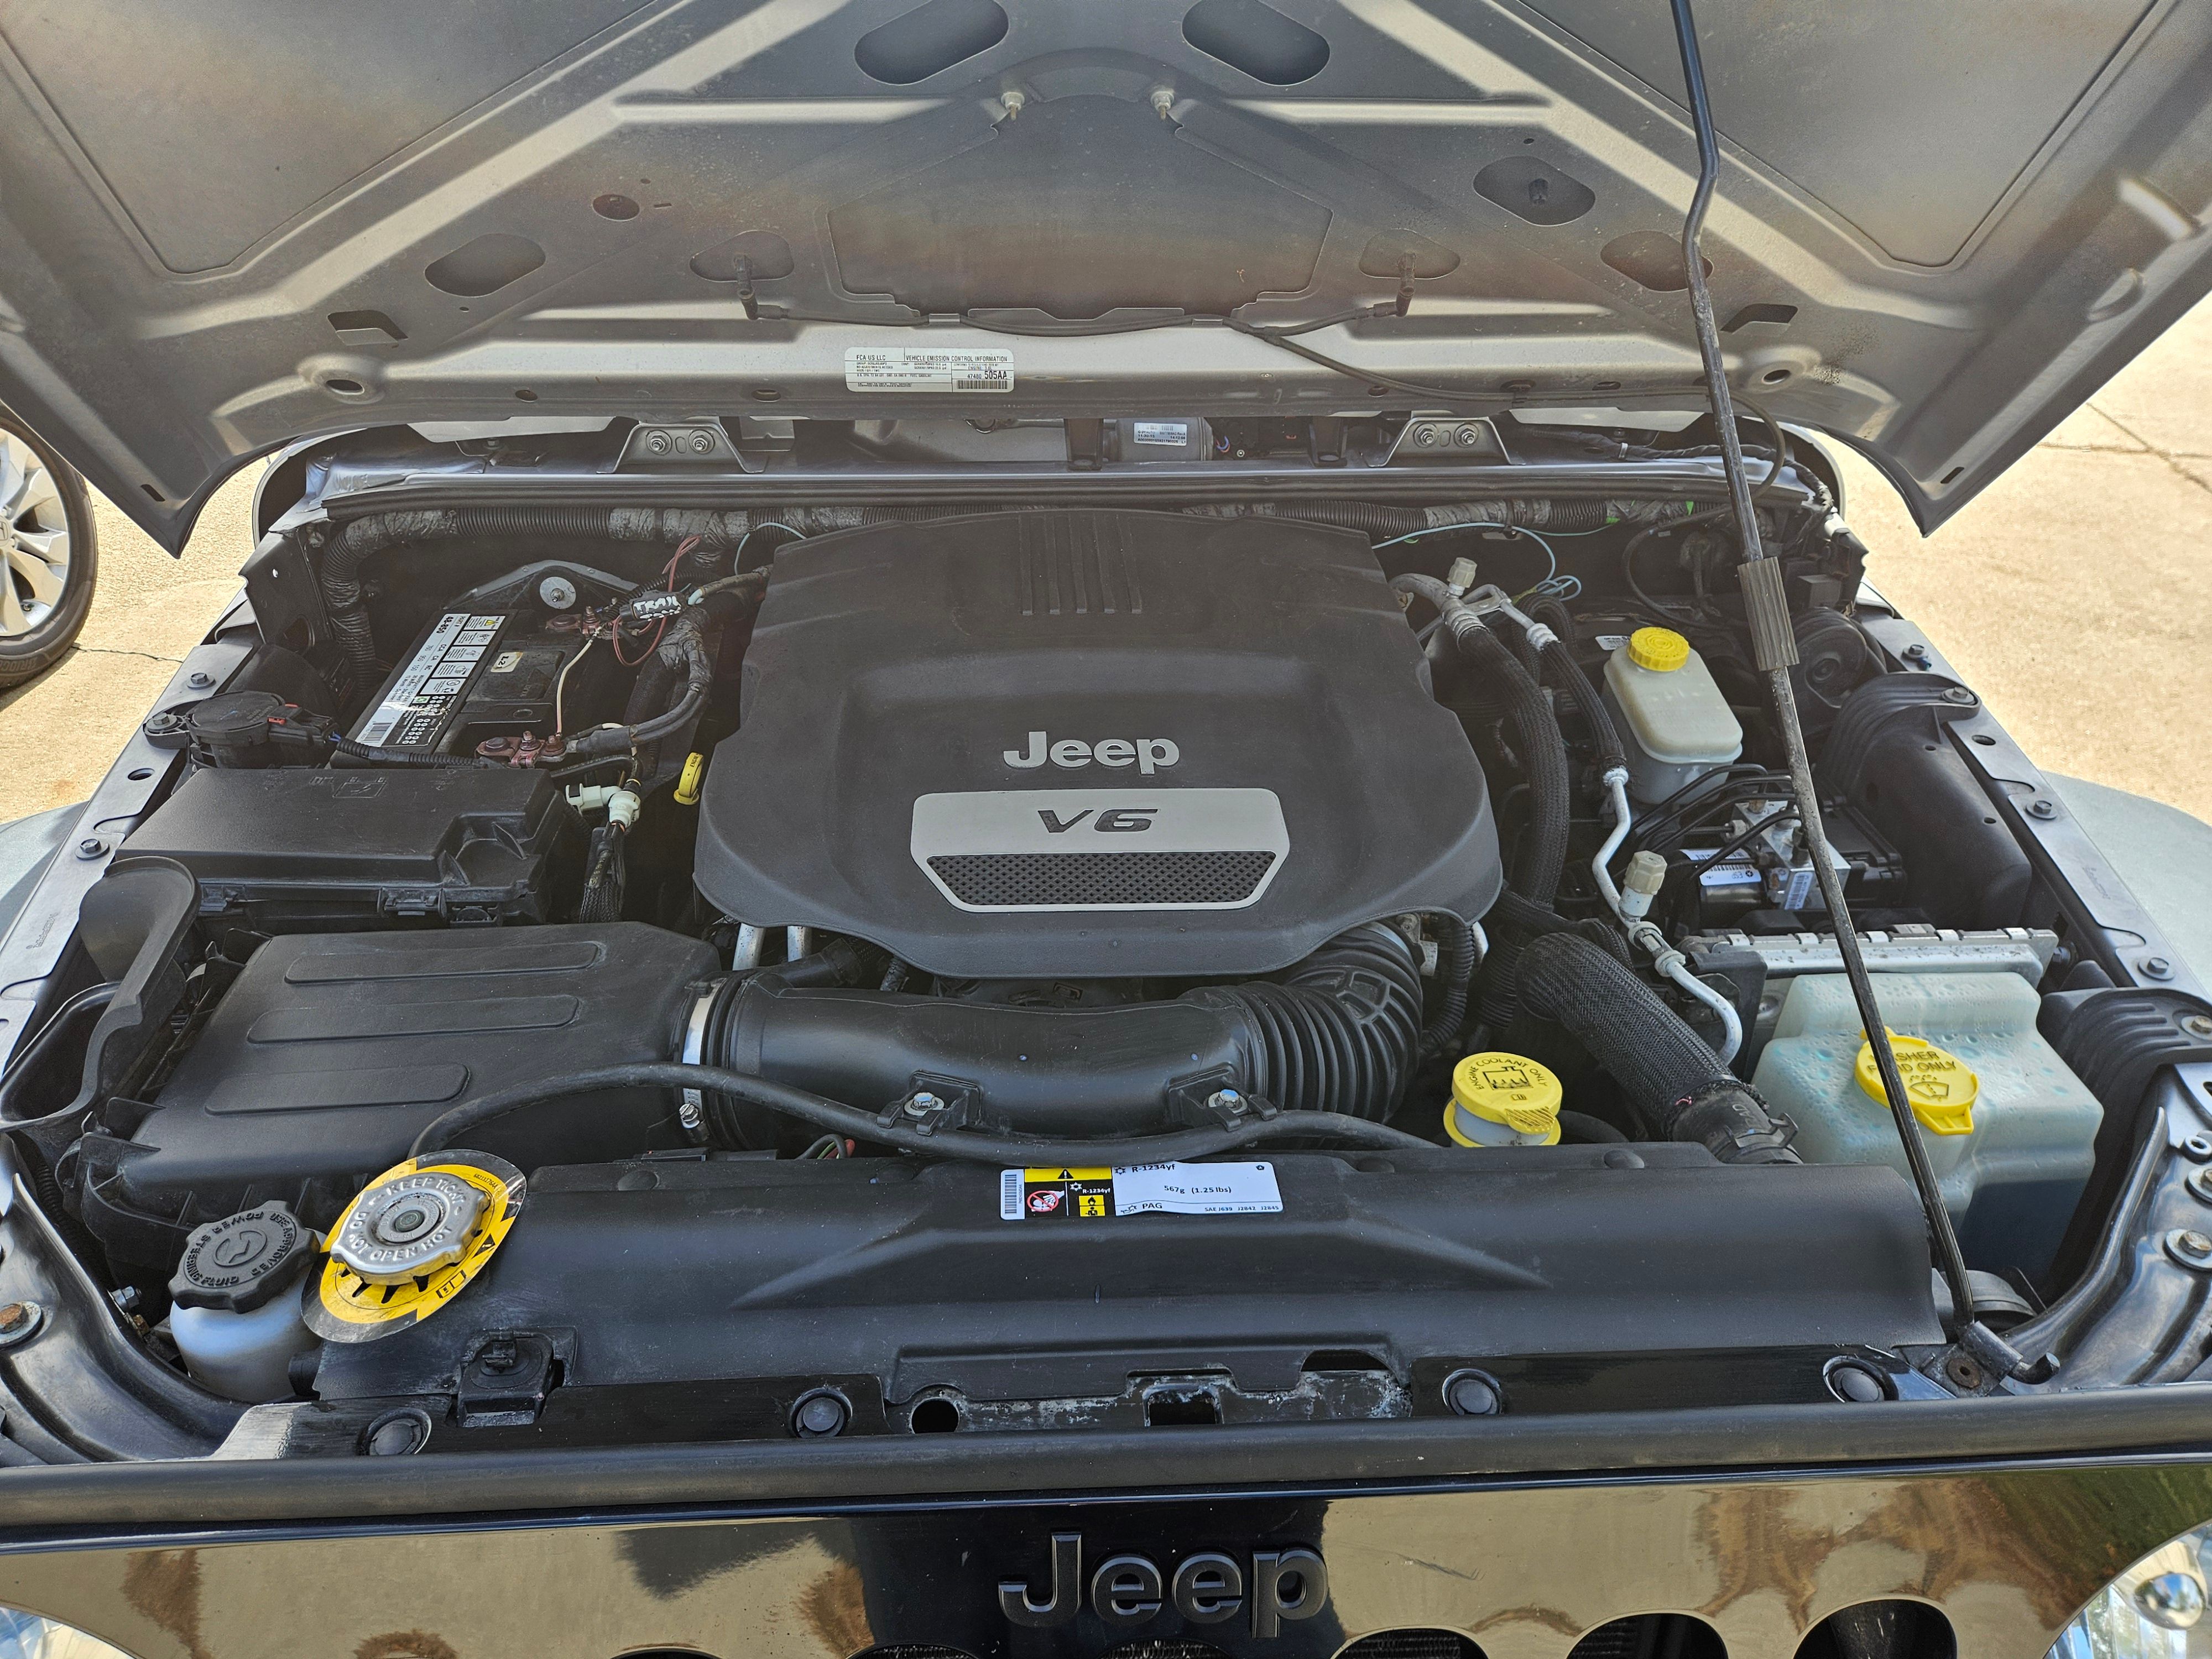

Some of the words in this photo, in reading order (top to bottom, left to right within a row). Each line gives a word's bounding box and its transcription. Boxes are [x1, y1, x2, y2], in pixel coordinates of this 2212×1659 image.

[984, 371, 1007, 379] 505AA
[436, 617, 454, 634] 48-850
[1003, 731, 1180, 774] Jeep
[1037, 808, 1159, 833] V6
[1870, 1051, 1940, 1062] SHER
[1468, 1066, 1484, 1091] ENGINE
[1477, 1057, 1528, 1068] COOLANT
[1530, 1068, 1548, 1087] ONLY
[1866, 1063, 1913, 1074] FID
[1917, 1061, 1957, 1072] ONLY
[1131, 1164, 1176, 1173] R-1234yf
[386, 1176, 435, 1196] KEEP
[1164, 1185, 1185, 1194] 567g
[1191, 1186, 1214, 1194] (1.25
[212, 1212, 264, 1234] POWER
[269, 1213, 290, 1227] USE
[349, 1211, 370, 1229] DO
[349, 1231, 373, 1255] NOT
[421, 1225, 452, 1251] HOT
[186, 1234, 212, 1281] STEERING
[251, 1227, 294, 1276] APPROVED
[370, 1246, 418, 1262] OPEN
[201, 1276, 240, 1287] FLUID
[998, 1531, 1327, 1638] Jeep
